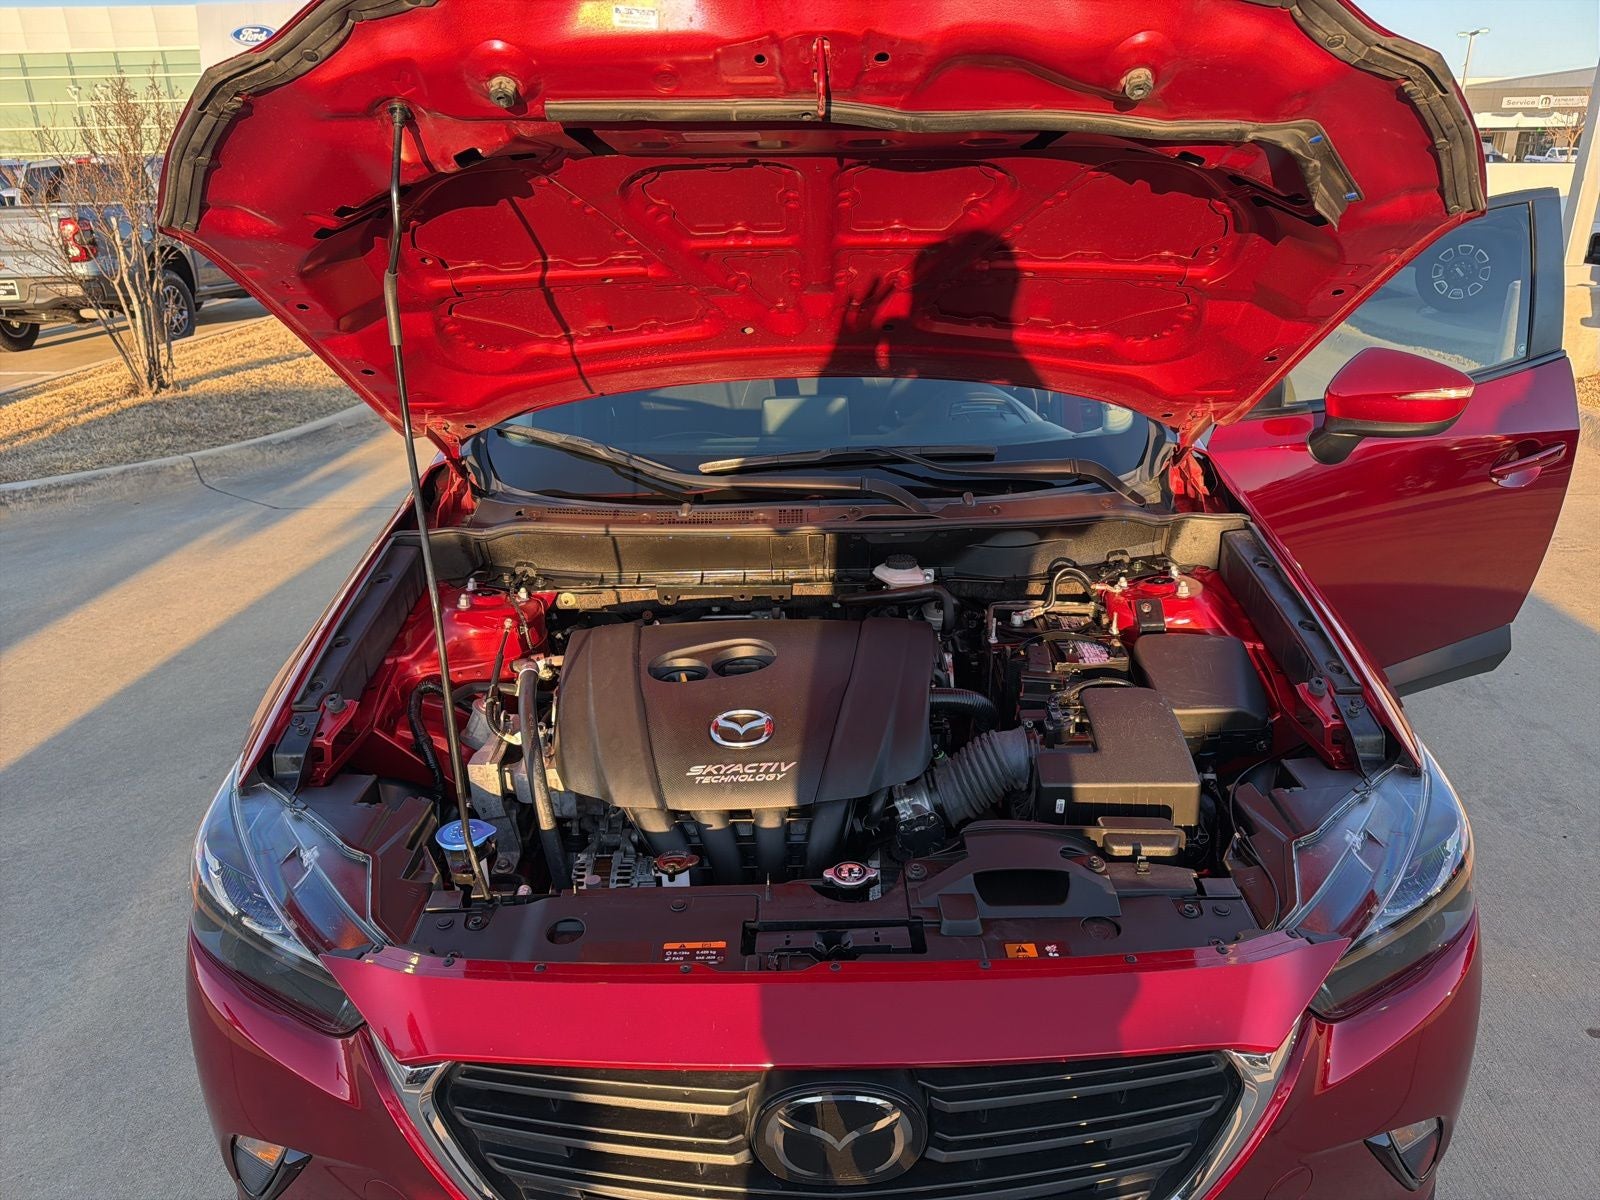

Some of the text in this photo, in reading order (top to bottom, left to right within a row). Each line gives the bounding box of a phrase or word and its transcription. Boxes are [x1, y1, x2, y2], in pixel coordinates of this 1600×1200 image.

[240, 28, 267, 41] Ford
[685, 761, 797, 776] SKYACTIV
[695, 773, 787, 784] TECHNOLOGY
